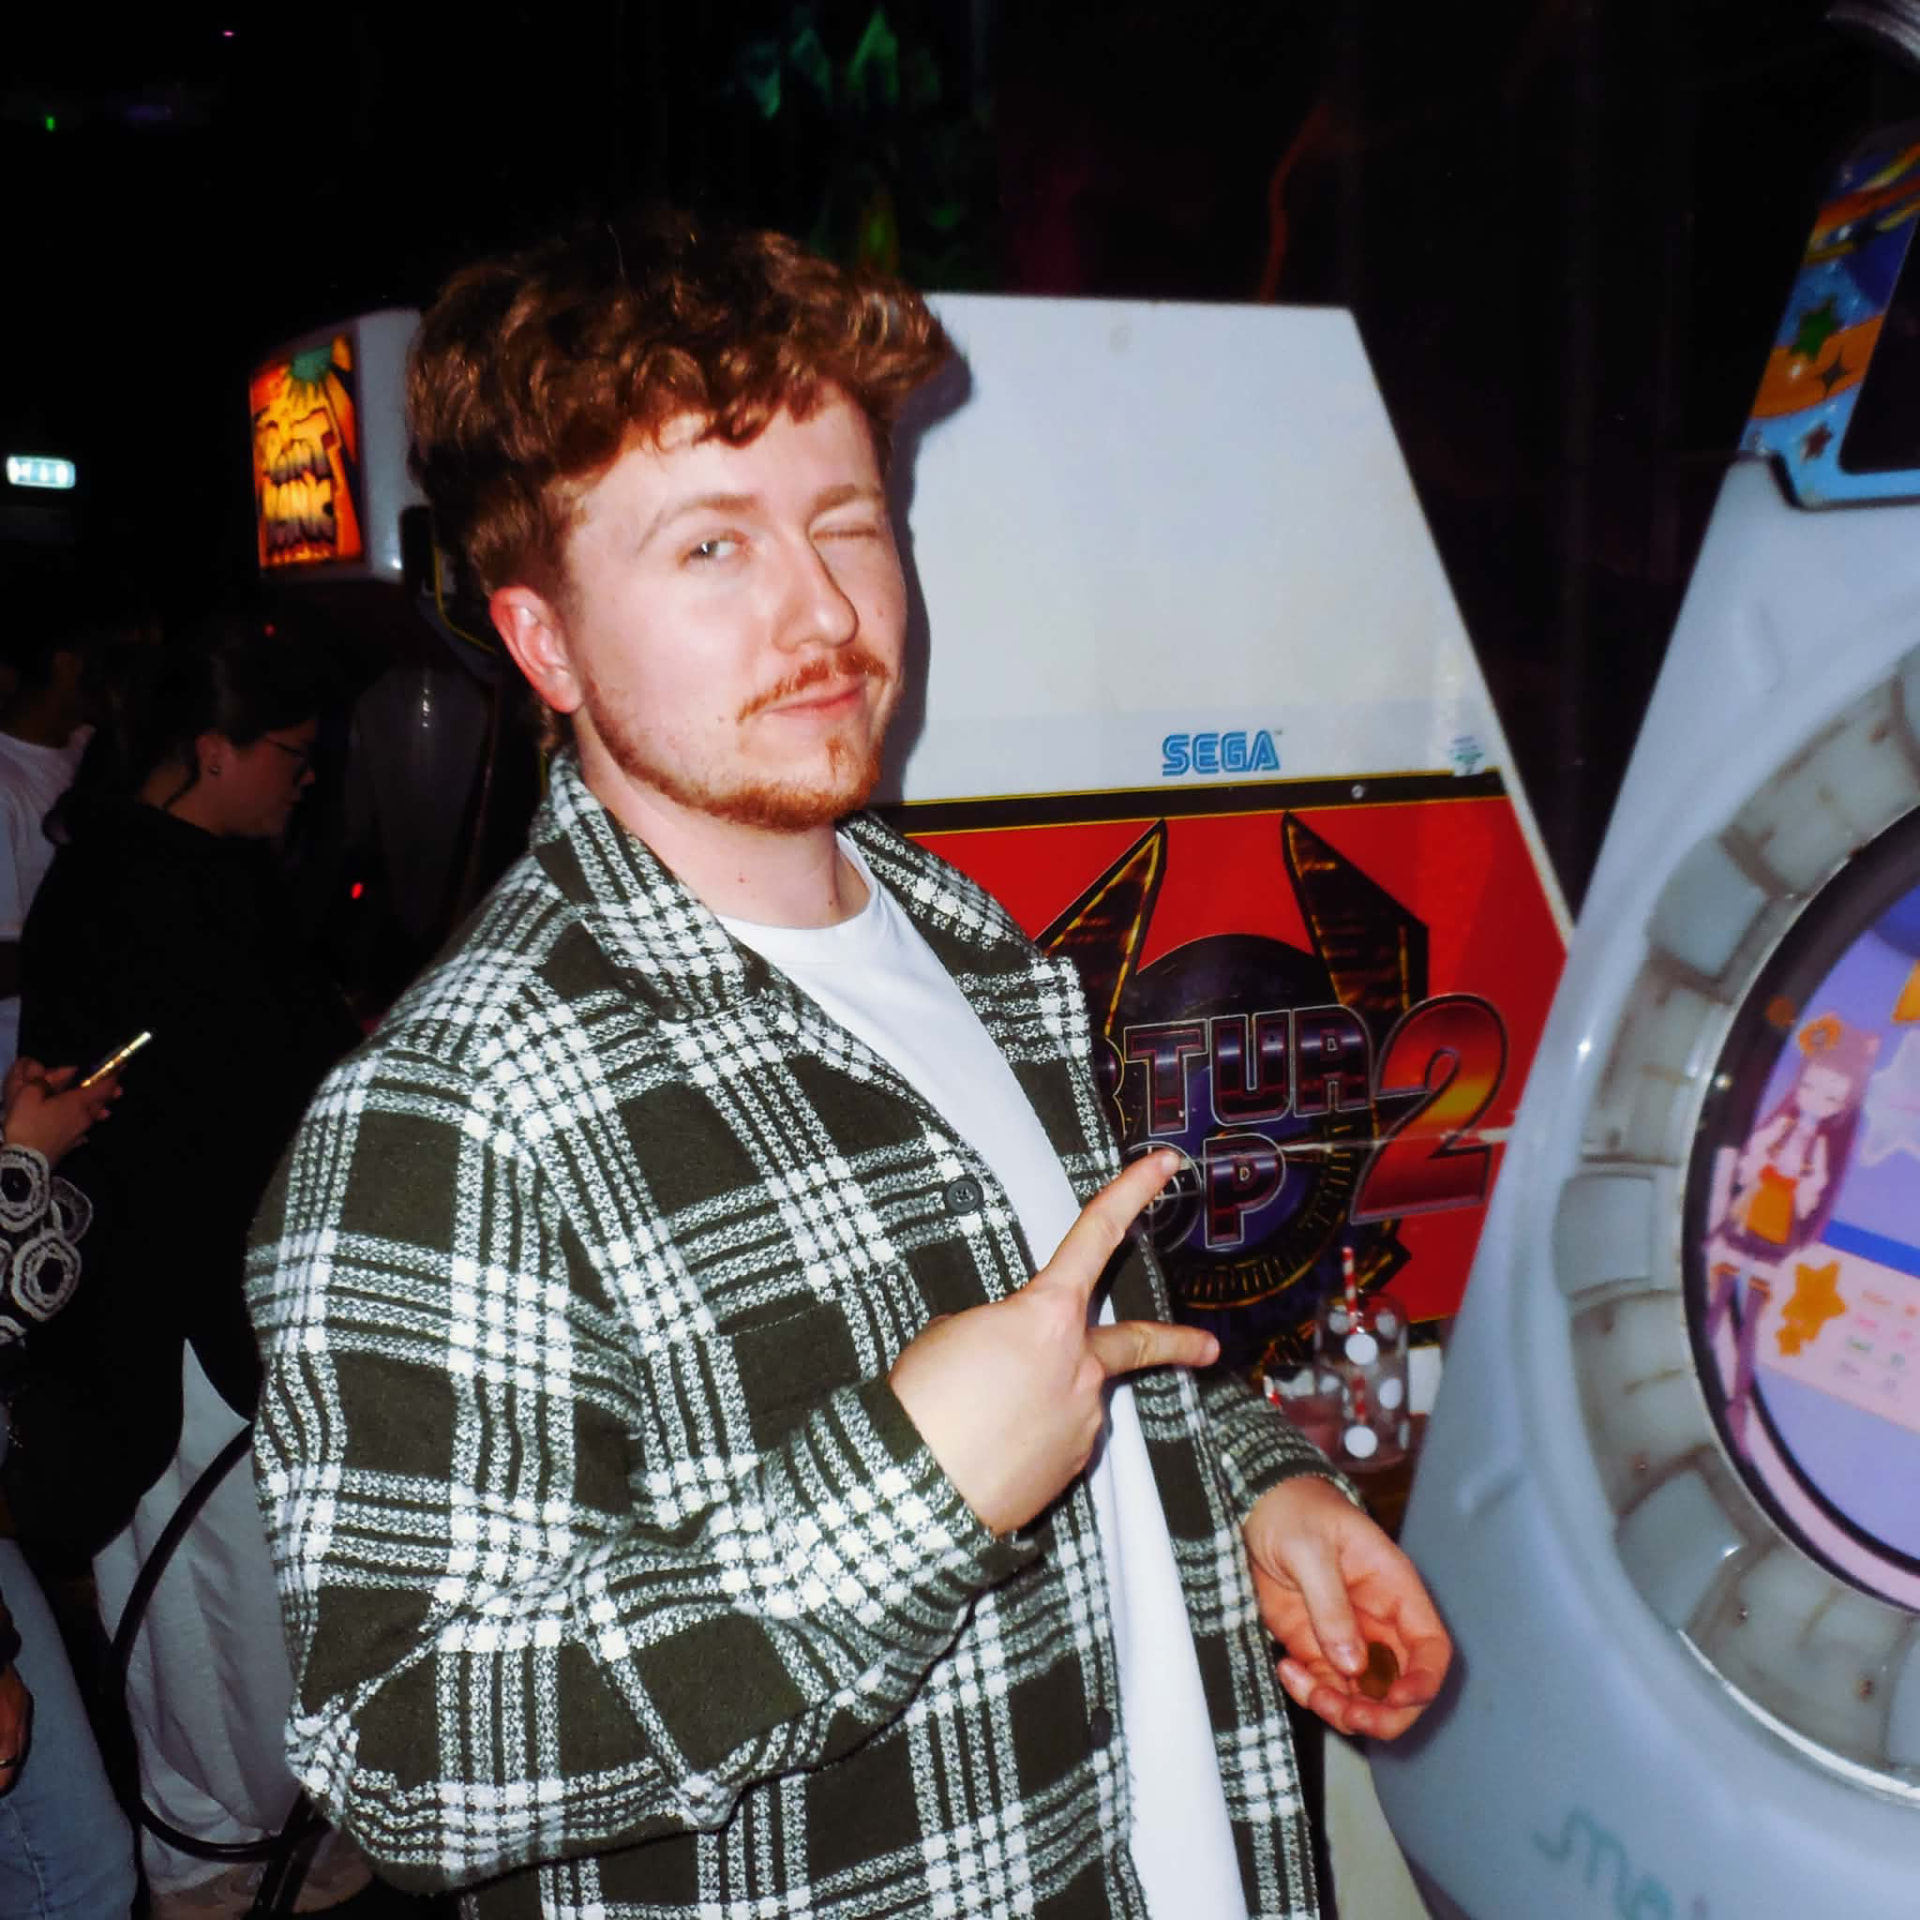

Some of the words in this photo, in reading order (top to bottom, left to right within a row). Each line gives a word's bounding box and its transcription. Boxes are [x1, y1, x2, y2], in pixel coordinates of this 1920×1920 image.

[1162, 730, 1280, 776] SEGA
[1104, 1004, 1372, 1140] TUA
[1350, 993, 1508, 1226] 2
